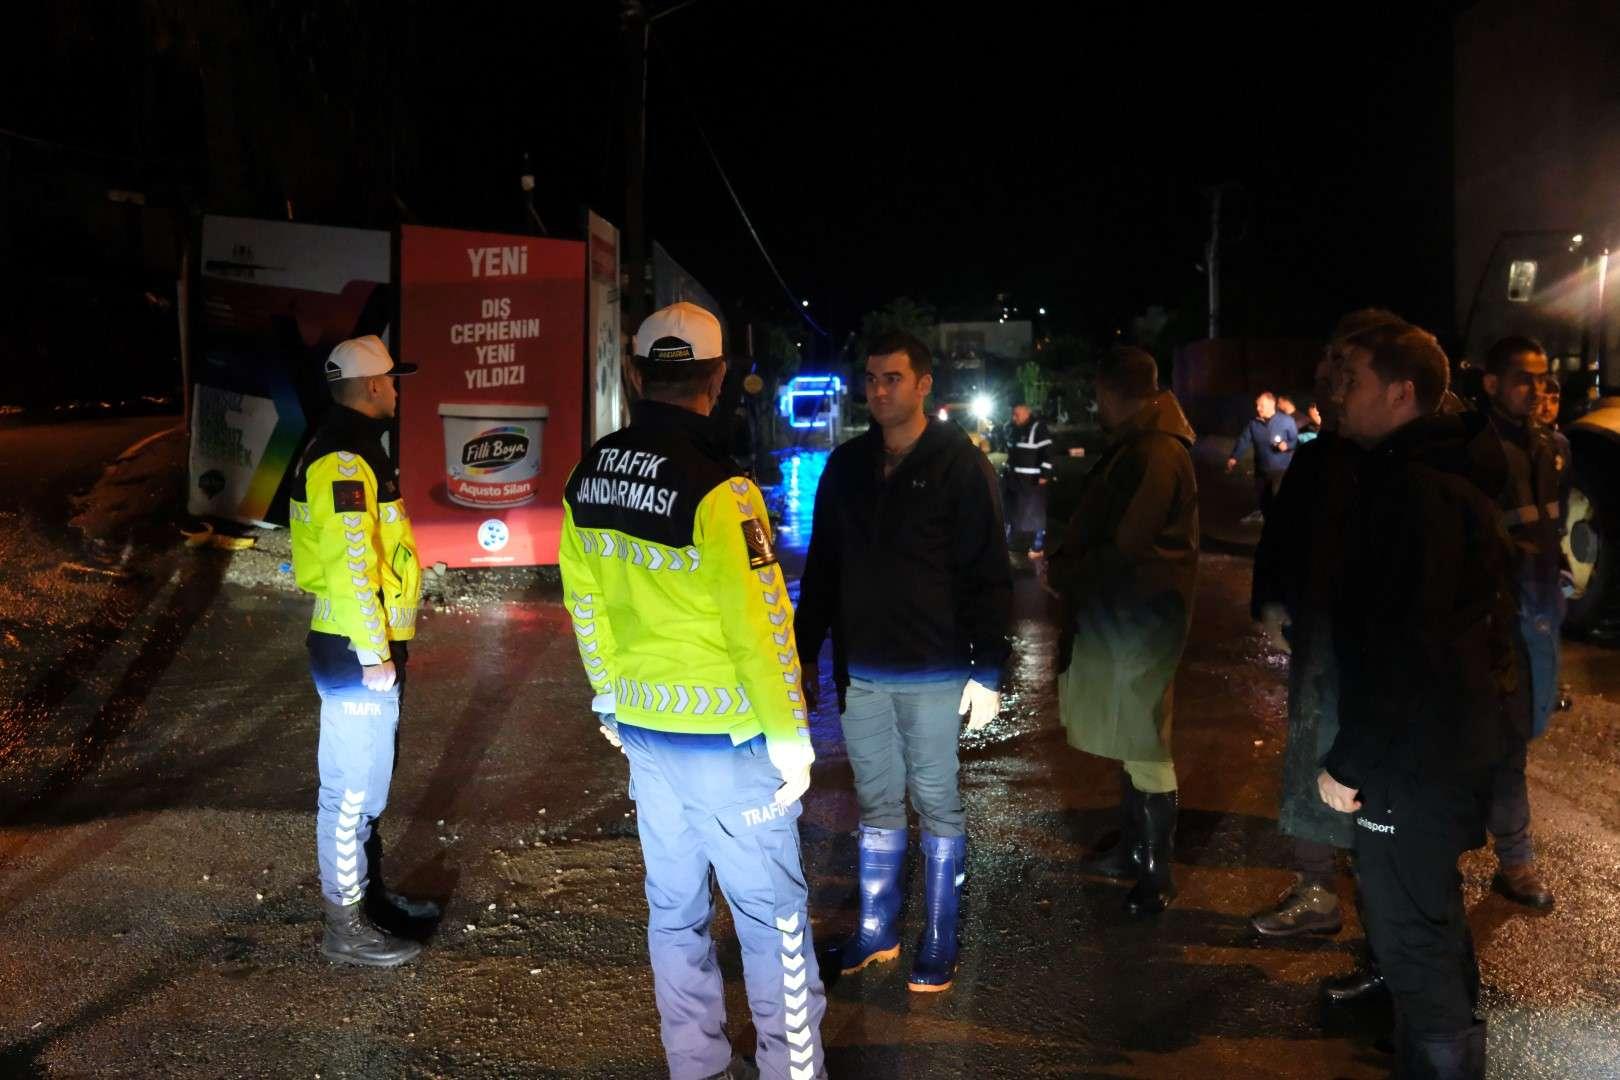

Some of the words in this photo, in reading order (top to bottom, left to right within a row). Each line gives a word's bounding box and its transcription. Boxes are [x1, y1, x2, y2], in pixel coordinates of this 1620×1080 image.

[481, 298, 511, 320] DIŞ
[464, 366, 525, 389] YILDIZI
[466, 441, 491, 462] Filli
[493, 439, 526, 461] Boya
[503, 483, 531, 495] Silan
[577, 477, 678, 517] JANDARMASI
